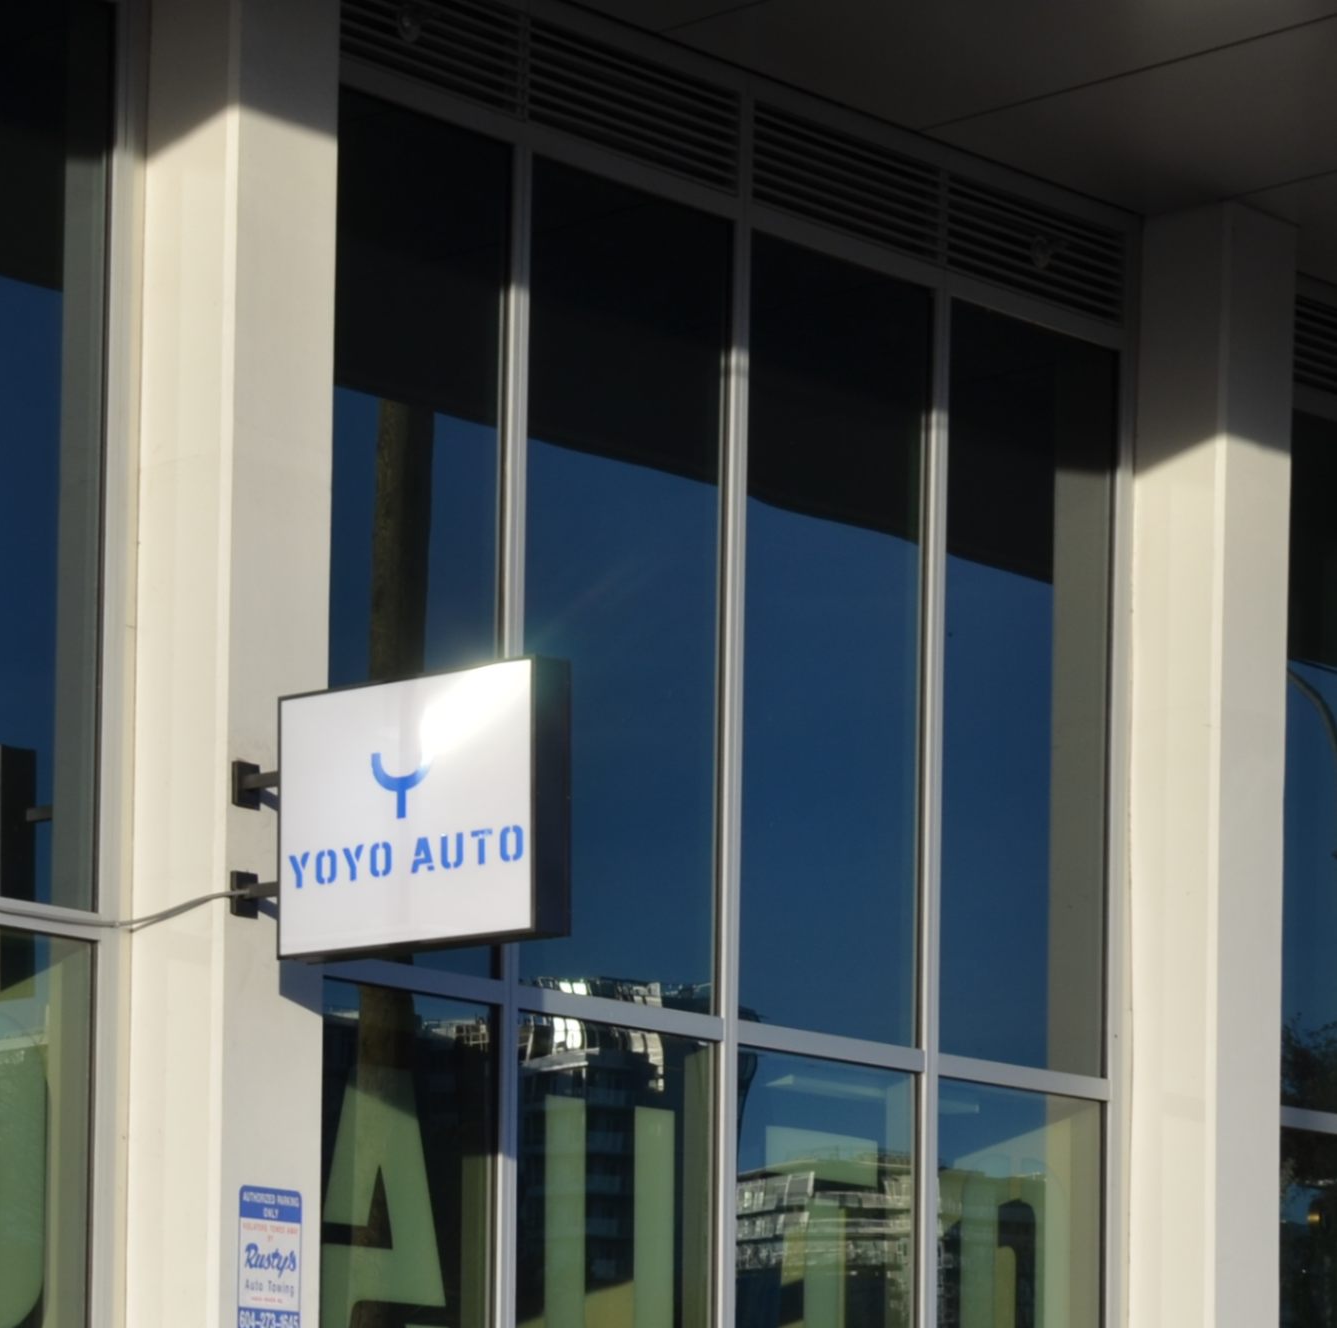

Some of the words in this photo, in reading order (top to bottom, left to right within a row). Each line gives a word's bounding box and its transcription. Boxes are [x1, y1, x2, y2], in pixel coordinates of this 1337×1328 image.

[289, 842, 392, 889] YOYO
[411, 825, 524, 874] AUTO
[263, 1207, 279, 1219] ONLY
[244, 1243, 297, 1278] Rusty's
[244, 1279, 264, 1291] Auto
[268, 1280, 295, 1298] Towing
